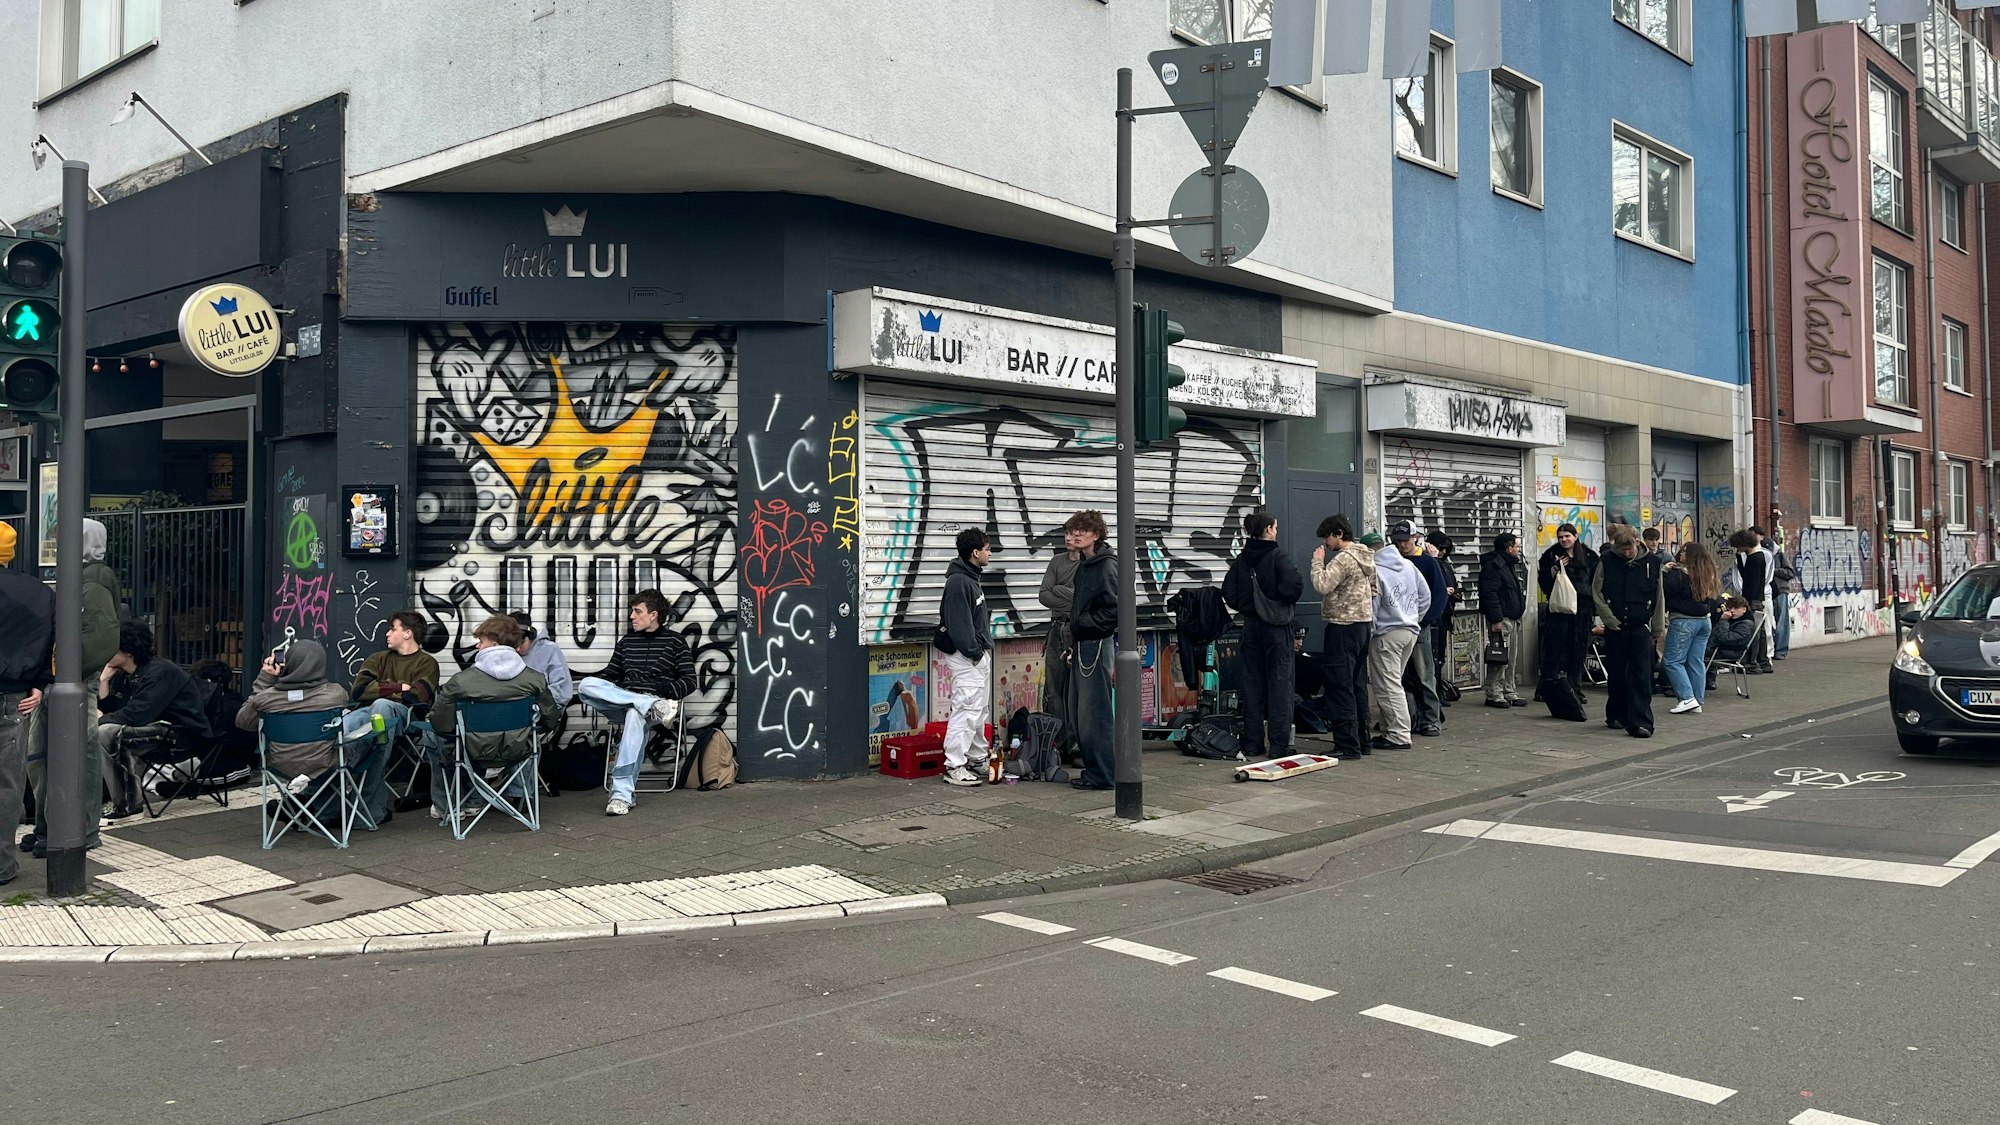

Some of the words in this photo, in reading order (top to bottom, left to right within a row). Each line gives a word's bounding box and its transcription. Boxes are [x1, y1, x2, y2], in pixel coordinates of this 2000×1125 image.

[502, 242, 560, 278] little
[565, 243, 628, 278] LUI
[198, 322, 236, 351] little
[231, 309, 273, 339] LUI
[215, 348, 235, 360] BAR
[247, 335, 270, 350] CAFÉ
[930, 336, 962, 364] LUI
[1007, 347, 1050, 376] BAR
[1084, 358, 1117, 384] CAF
[1186, 373, 1212, 384] KAFFEE
[1221, 377, 1247, 388] KUCHEN
[1279, 397, 1298, 407] MUSIK
[868, 653, 884, 662] ntje
[886, 651, 922, 661] Schomaker
[1970, 692, 1993, 704] CUX
